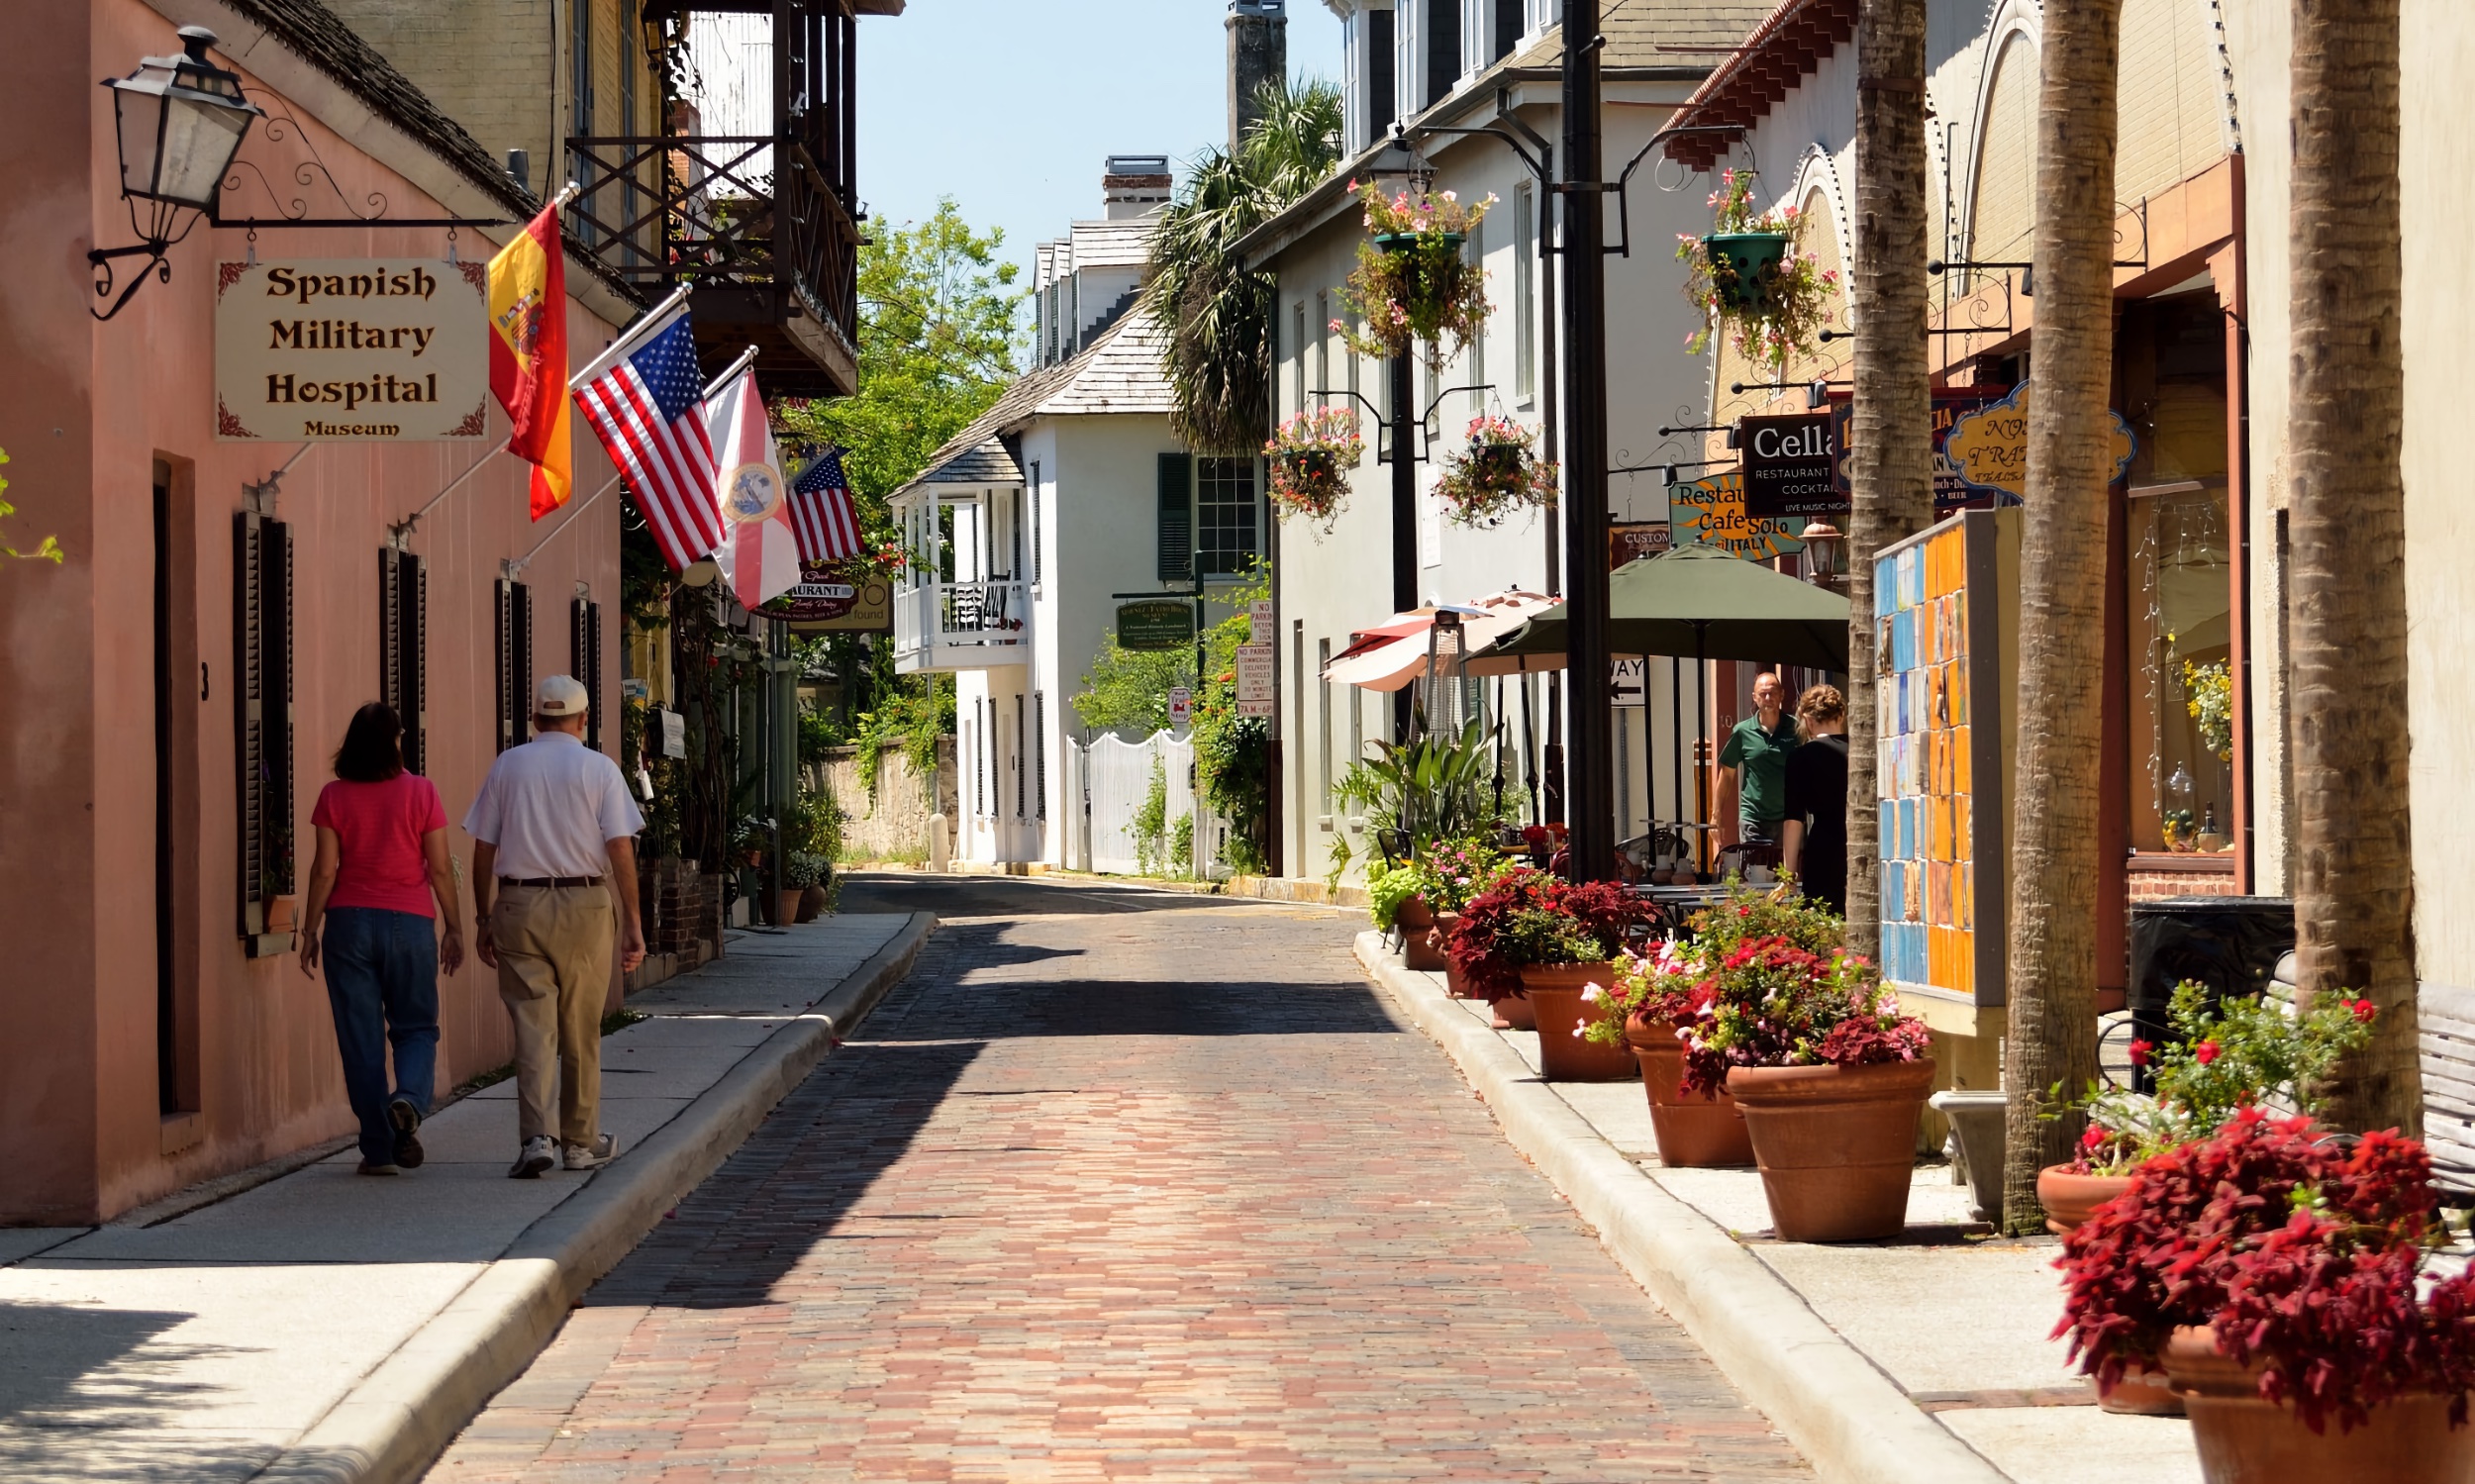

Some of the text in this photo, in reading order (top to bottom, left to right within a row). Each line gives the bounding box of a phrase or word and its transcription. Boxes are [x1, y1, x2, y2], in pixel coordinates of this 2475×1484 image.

[266, 266, 437, 305] Spanish
[268, 319, 436, 357] Military
[265, 372, 439, 411] Hospital
[304, 420, 401, 437] Museum
[1755, 467, 1830, 479] RESTAURANT
[1975, 471, 2026, 483] ITALIA
[1785, 504, 1801, 513] LIVE
[1802, 503, 1827, 512] MUSIC
[1699, 508, 1789, 535] Cafe Solo
[1731, 536, 1767, 551] ITALY
[853, 609, 884, 620] found
[1258, 603, 1270, 612] NO
